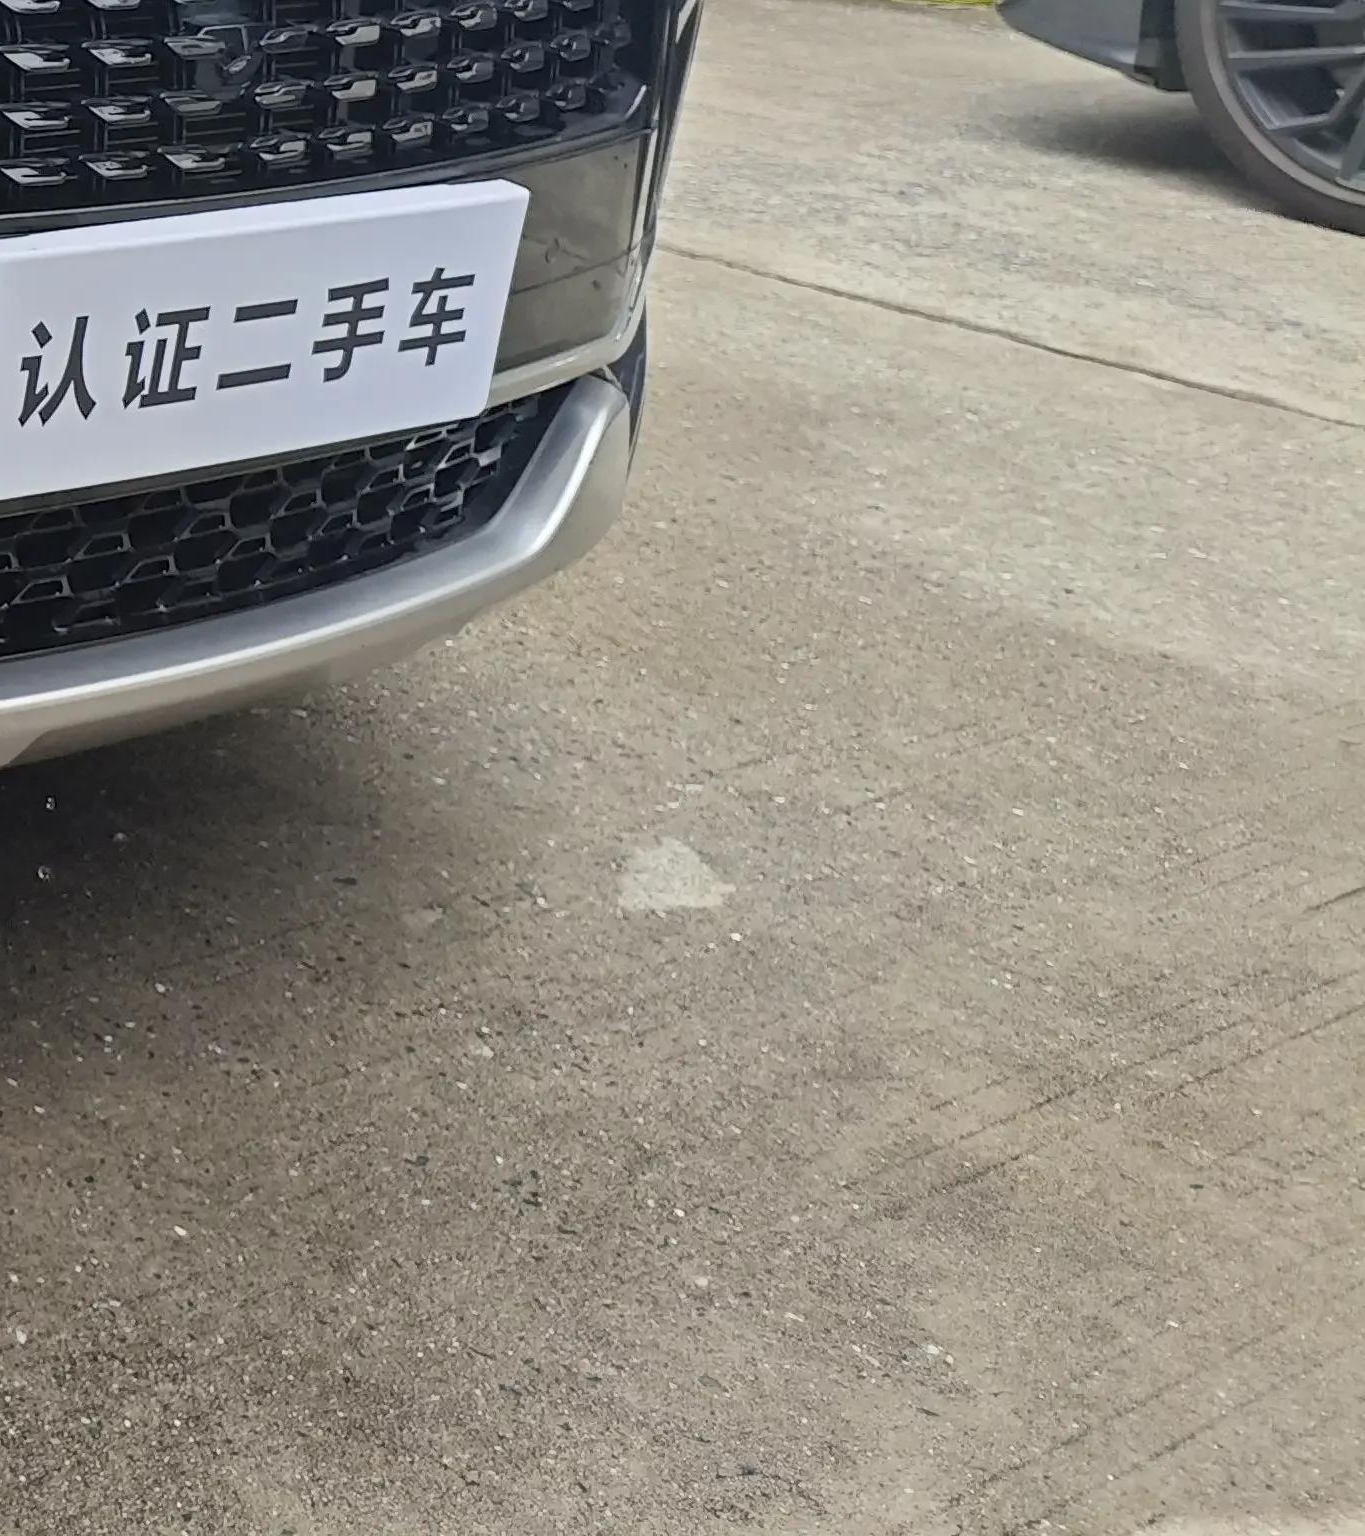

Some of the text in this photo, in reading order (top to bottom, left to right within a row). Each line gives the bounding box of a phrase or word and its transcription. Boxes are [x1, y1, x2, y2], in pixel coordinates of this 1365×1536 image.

[17, 267, 475, 427] 认证二手车
